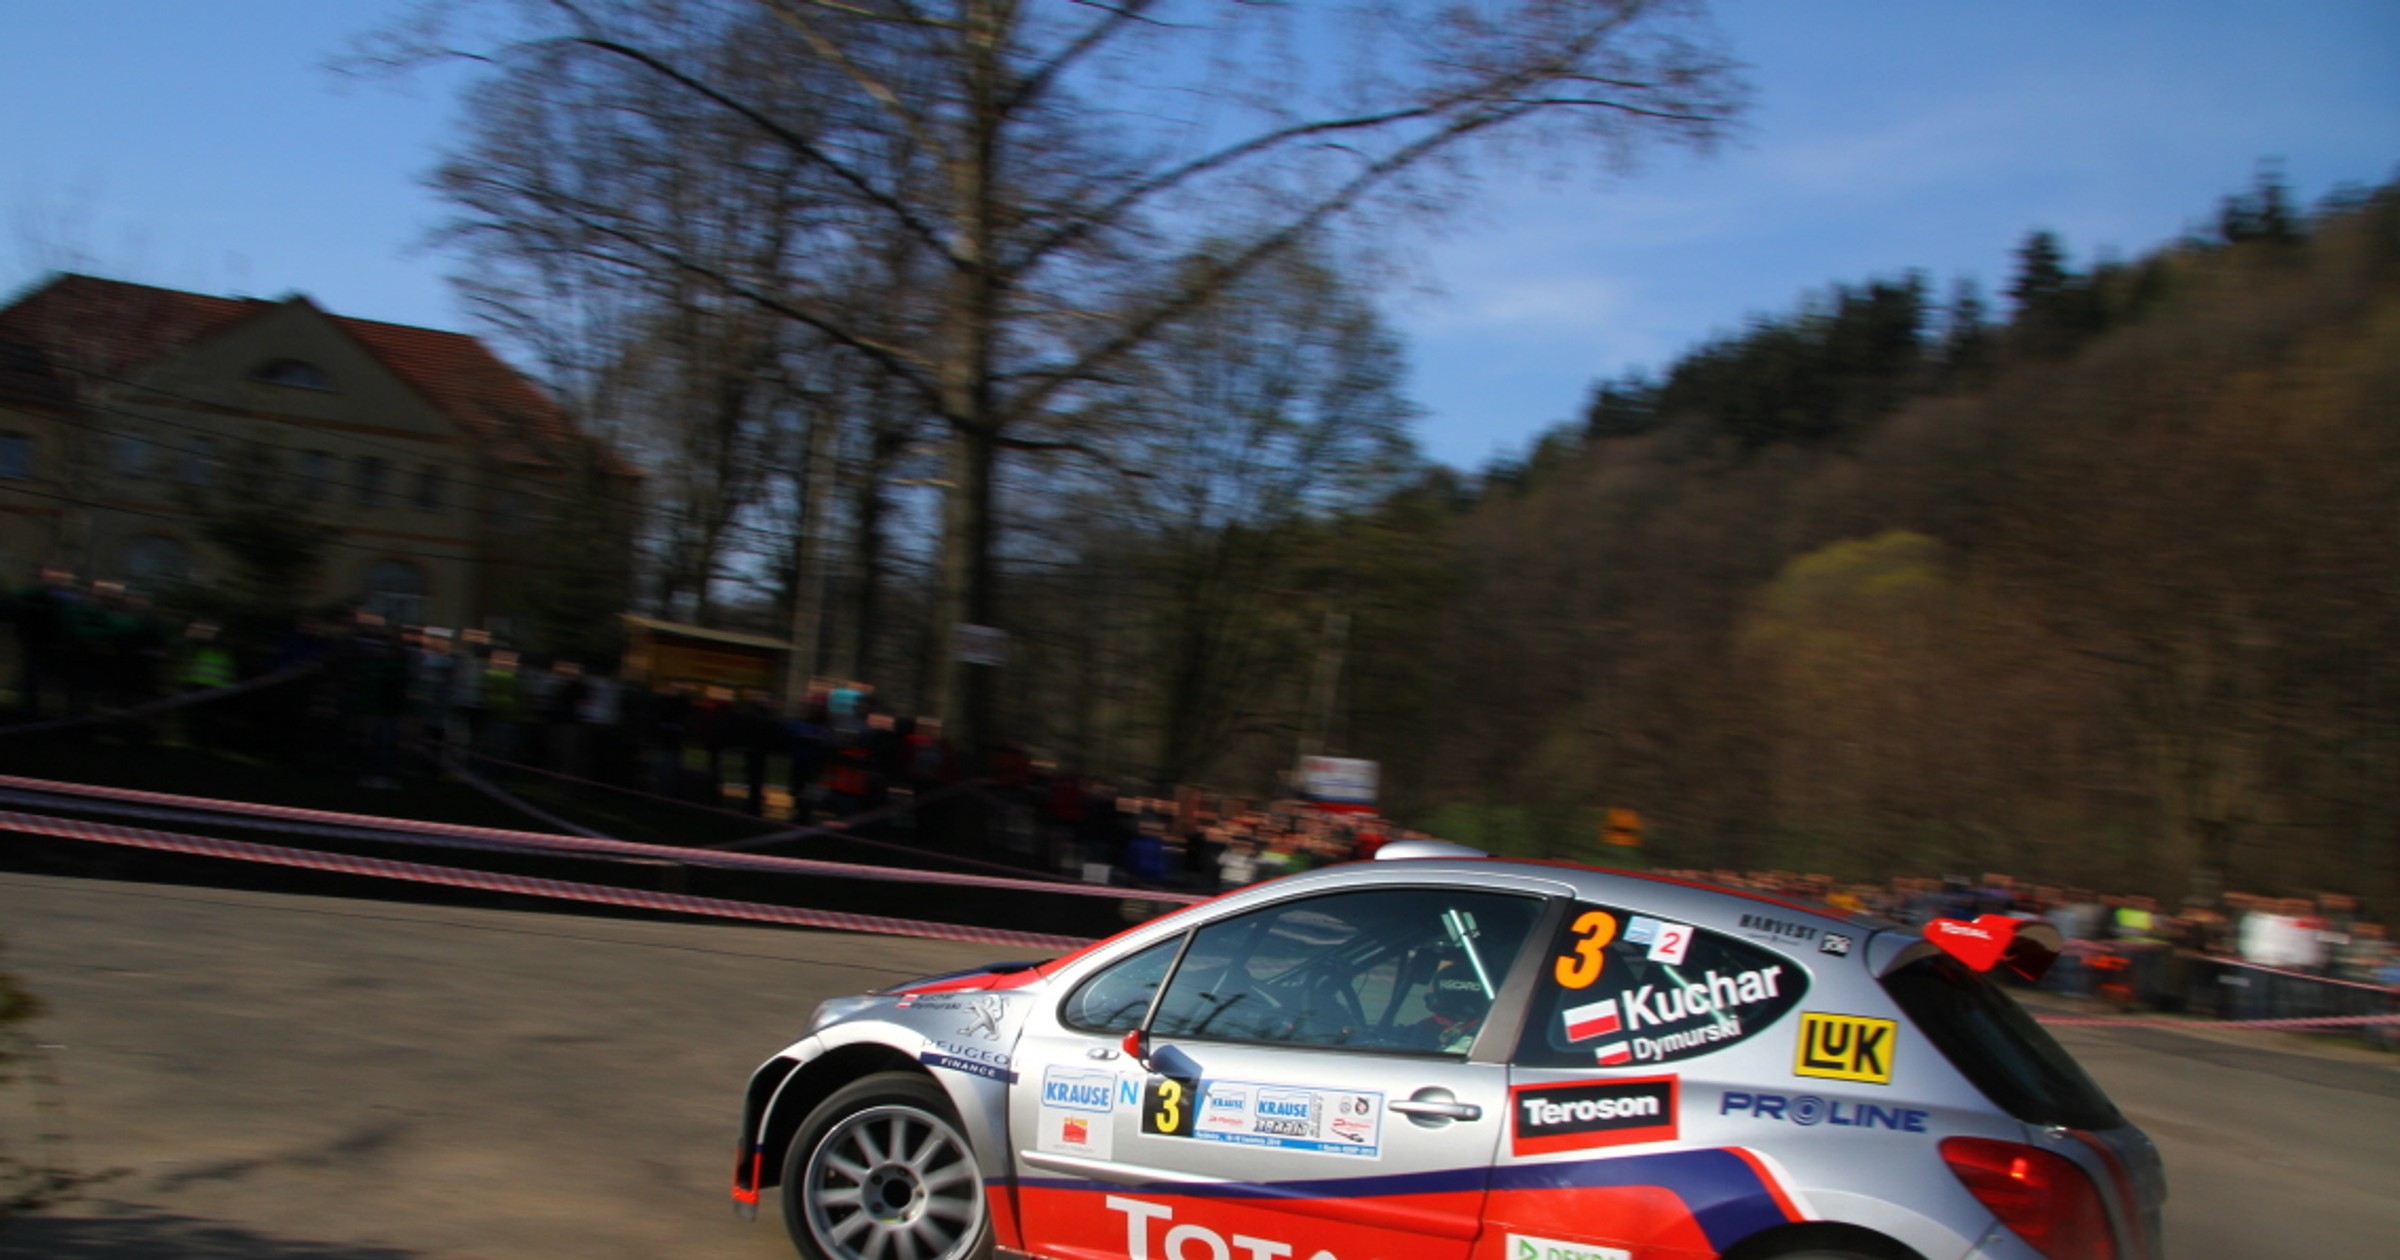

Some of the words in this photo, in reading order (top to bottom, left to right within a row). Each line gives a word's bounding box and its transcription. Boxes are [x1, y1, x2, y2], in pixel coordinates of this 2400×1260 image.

[1739, 913, 1816, 941] HARVEST
[1554, 911, 1617, 990] 3
[1657, 932, 1681, 954] 2
[1621, 965, 1782, 1031] Kuchar
[922, 1037, 1019, 1067] PEUGEO
[1632, 1014, 1742, 1062] Dymurski
[941, 1057, 997, 1078] FINANCE
[1045, 1081, 1111, 1107] KRAUSE
[1120, 1080, 1140, 1105] N
[1155, 1079, 1182, 1133] 3
[1258, 1100, 1309, 1117] KRAUSE
[1523, 1095, 1660, 1126] Teroson
